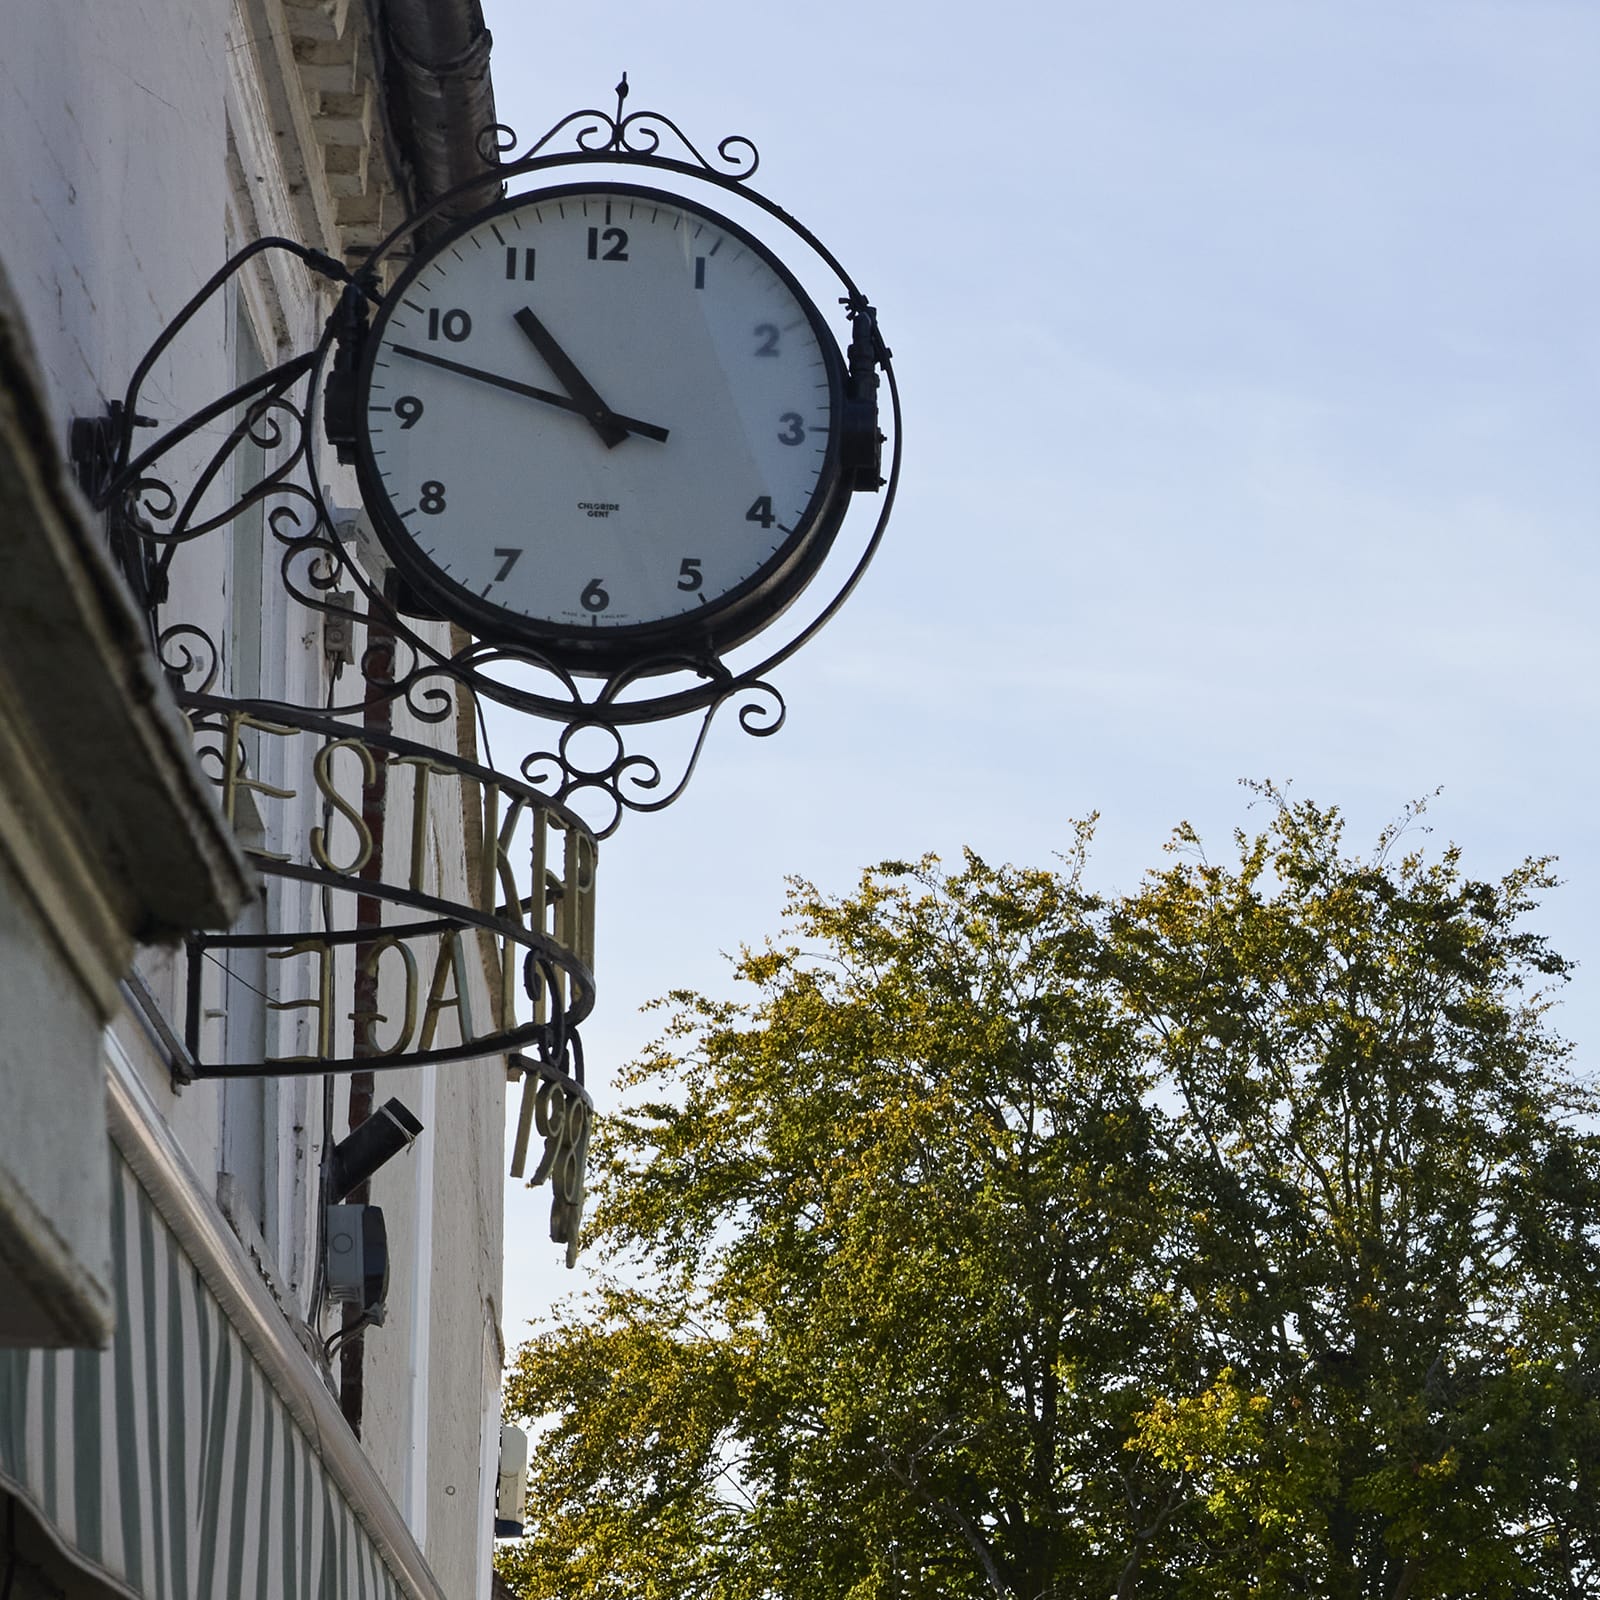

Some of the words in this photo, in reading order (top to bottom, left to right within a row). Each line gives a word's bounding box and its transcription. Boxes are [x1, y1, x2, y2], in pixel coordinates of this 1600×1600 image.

[588, 228, 628, 261] 12
[506, 247, 535, 281] 11
[694, 257, 705, 289] 1
[428, 308, 472, 342] 10
[753, 324, 780, 357] 2
[394, 396, 424, 429] 9
[777, 413, 806, 446] 3
[419, 481, 446, 515] 8
[577, 502, 620, 511] CHLORIDE
[587, 510, 609, 518] GENT
[745, 496, 775, 528] 4
[494, 549, 523, 582] 7
[677, 558, 704, 592] 5
[580, 578, 610, 612] 6
[180, 705, 457, 893] EST
